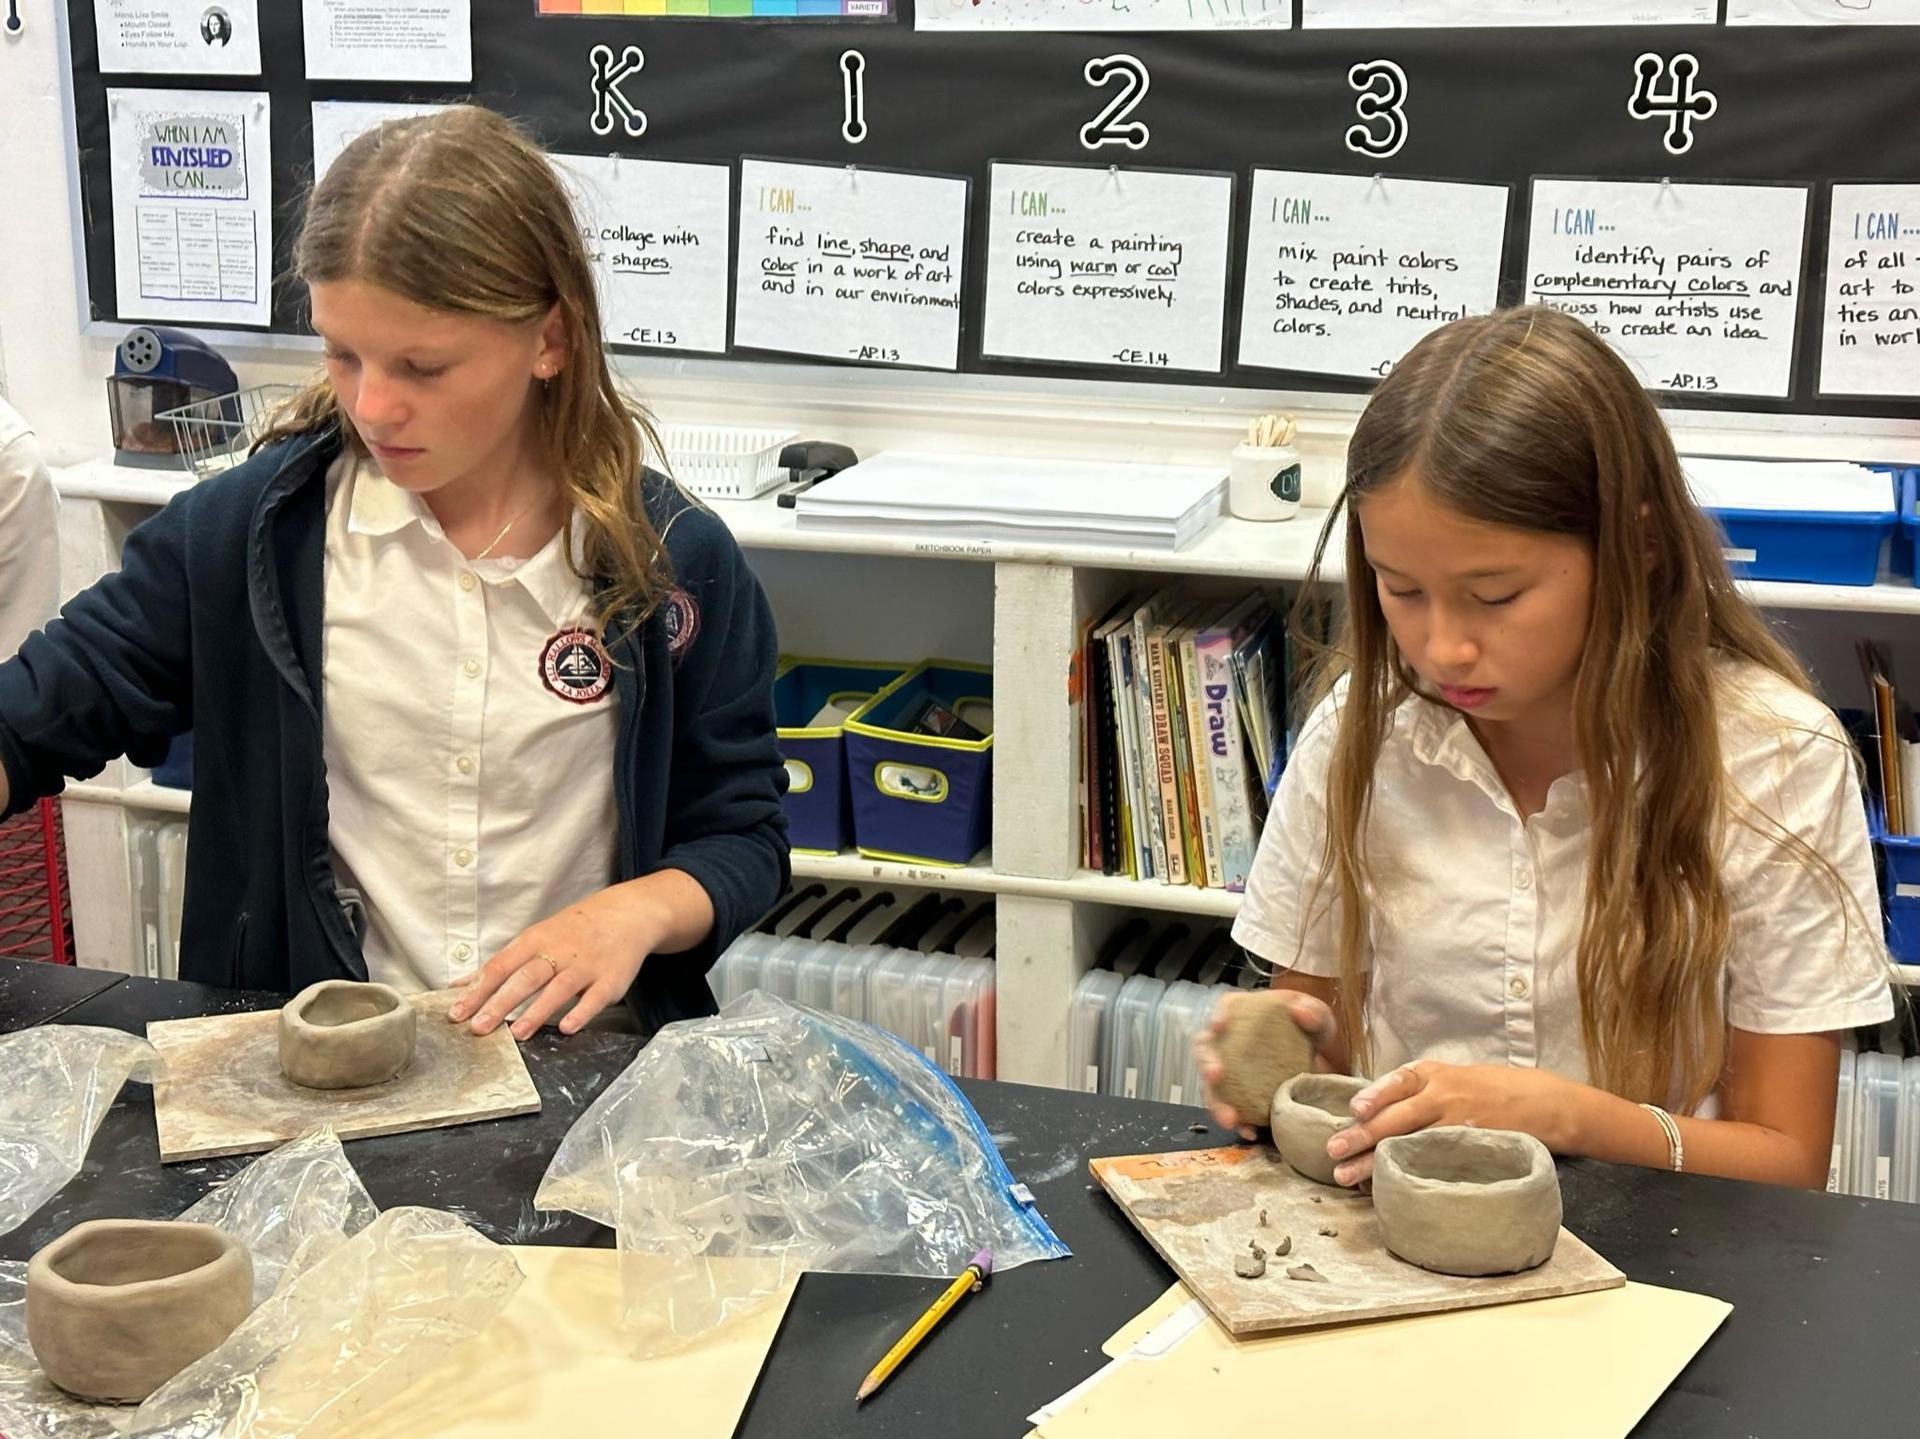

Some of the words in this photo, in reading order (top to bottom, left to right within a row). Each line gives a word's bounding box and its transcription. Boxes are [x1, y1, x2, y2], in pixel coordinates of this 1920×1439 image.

[850, 3, 880, 11] VARIETY
[589, 44, 647, 136] K
[1080, 53, 1150, 150] 2
[1627, 52, 1717, 154] 4
[1344, 58, 1408, 158] 3
[155, 125, 189, 143] WHEN
[193, 126, 198, 143] I
[202, 126, 227, 144] AM
[151, 146, 232, 168] FINISHED
[165, 170, 169, 187] I
[760, 186, 764, 212] I
[1010, 190, 1015, 215] I
[1272, 197, 1277, 223] I
[1553, 208, 1558, 235] I
[1854, 212, 1859, 240] I
[601, 224, 656, 251] collage
[663, 225, 699, 246] with
[765, 226, 804, 248] find
[817, 231, 855, 255] line,
[860, 238, 914, 260] shape,
[919, 244, 949, 262] and
[1016, 228, 1076, 248] create
[1090, 237, 1104, 249] a
[1111, 233, 1183, 265] painting
[612, 252, 672, 270] shapes.
[1016, 251, 1062, 280] using
[1070, 260, 1117, 273] warm
[1125, 262, 1142, 273] or
[1278, 242, 1317, 262] mix
[1333, 244, 1388, 271] paint
[1399, 250, 1459, 272] colors
[1575, 245, 1665, 275] identify
[1677, 247, 1732, 272] pairs
[1745, 250, 1770, 269] of
[1844, 249, 1868, 269] of
[1878, 251, 1905, 269] all
[807, 257, 823, 274] in
[834, 264, 846, 276] a
[854, 265, 898, 280] work
[904, 263, 925, 281] of
[926, 269, 952, 284] art
[762, 279, 795, 295] and
[806, 280, 824, 296] in
[836, 287, 864, 299] our
[1273, 270, 1295, 286] to
[1309, 274, 1374, 291] create
[1386, 276, 1438, 300] tints,
[1759, 280, 1792, 297] and
[1840, 278, 1874, 296] art
[1891, 278, 1914, 294] to
[1348, 297, 1383, 315] and
[1396, 304, 1466, 322] neutral
[1538, 296, 1598, 314] scuss
[1609, 301, 1641, 315] how
[1655, 298, 1719, 317] artists
[1730, 306, 1763, 321] use
[1838, 302, 1879, 323] ties
[1888, 308, 1920, 322] an
[1589, 321, 1610, 333] to
[1621, 322, 1677, 335] create
[1687, 325, 1712, 337] an
[1723, 320, 1768, 340] idea
[1840, 328, 1857, 346] in
[914, 543, 964, 553] SKETCHBOOK
[966, 545, 992, 555] PAPER
[1151, 642, 1160, 666] MARK
[1155, 713, 1168, 745] DRAW
[1205, 684, 1228, 756] Draw
[1159, 747, 1172, 784] SQUAD
